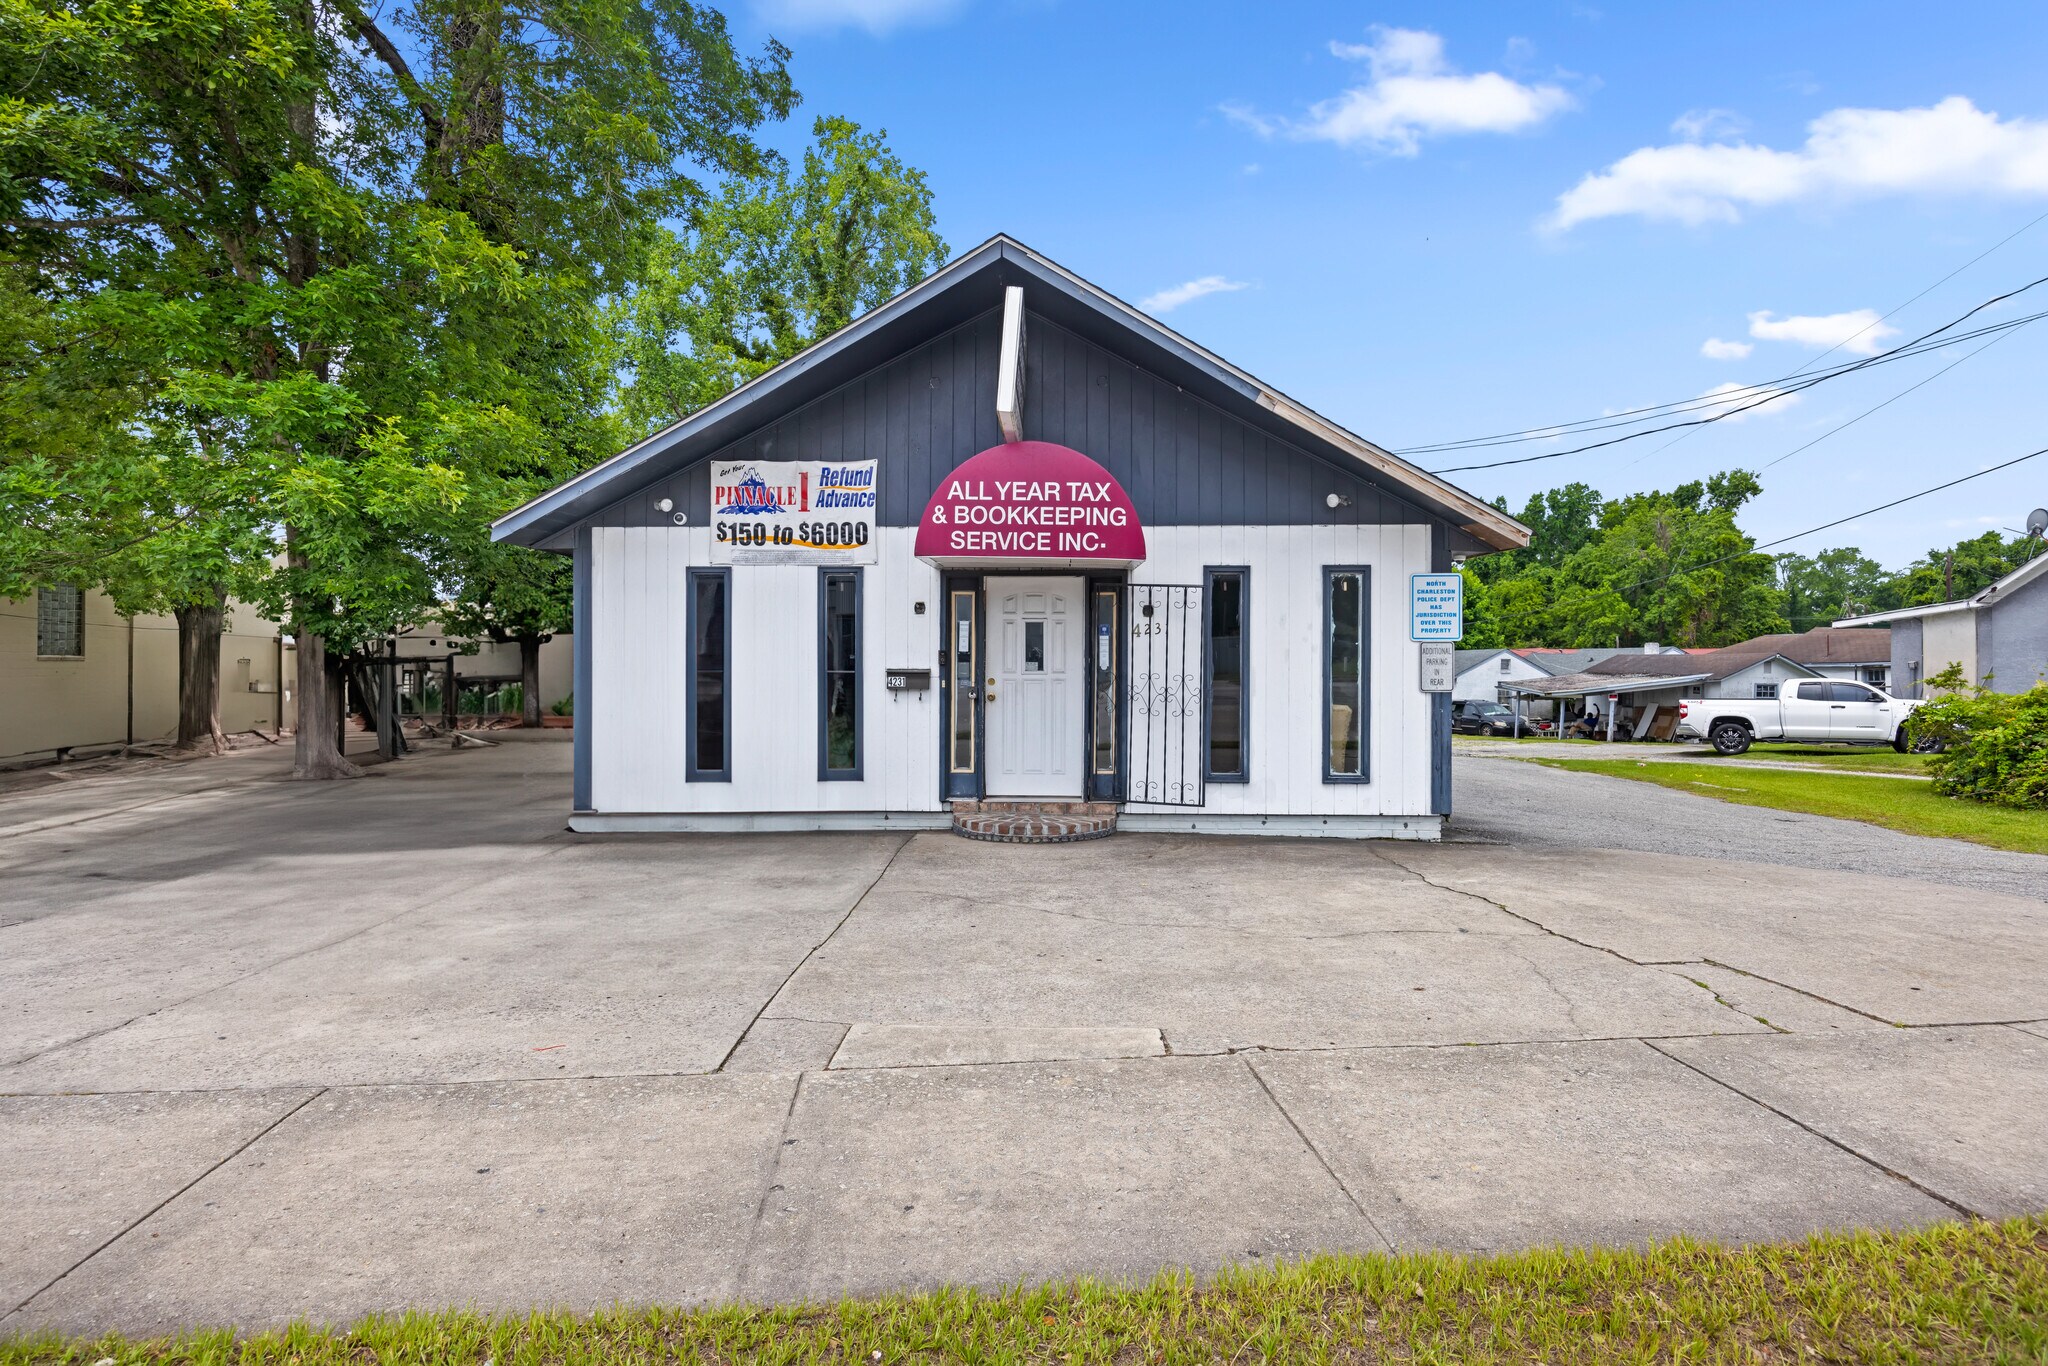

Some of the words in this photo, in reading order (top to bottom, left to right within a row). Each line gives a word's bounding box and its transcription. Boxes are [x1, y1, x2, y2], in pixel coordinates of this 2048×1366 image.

[732, 465, 746, 473] Your
[819, 466, 874, 487] Refund
[714, 486, 797, 506] PINNACLE
[815, 489, 876, 508] Advance
[947, 481, 992, 501] ALL
[995, 481, 1060, 502] YEAR
[1066, 482, 1111, 502] TAX
[932, 505, 948, 524] &
[954, 505, 1127, 526] BOOKKEEPING
[716, 521, 767, 546] $150
[773, 524, 794, 546] to
[799, 521, 869, 546] $6000
[950, 531, 1051, 551] SERVICE
[1059, 532, 1106, 551] INC.
[1423, 647, 1452, 655] ADDITIONAL
[1426, 658, 1448, 666] PARKING
[1430, 678, 1445, 686] REAR
